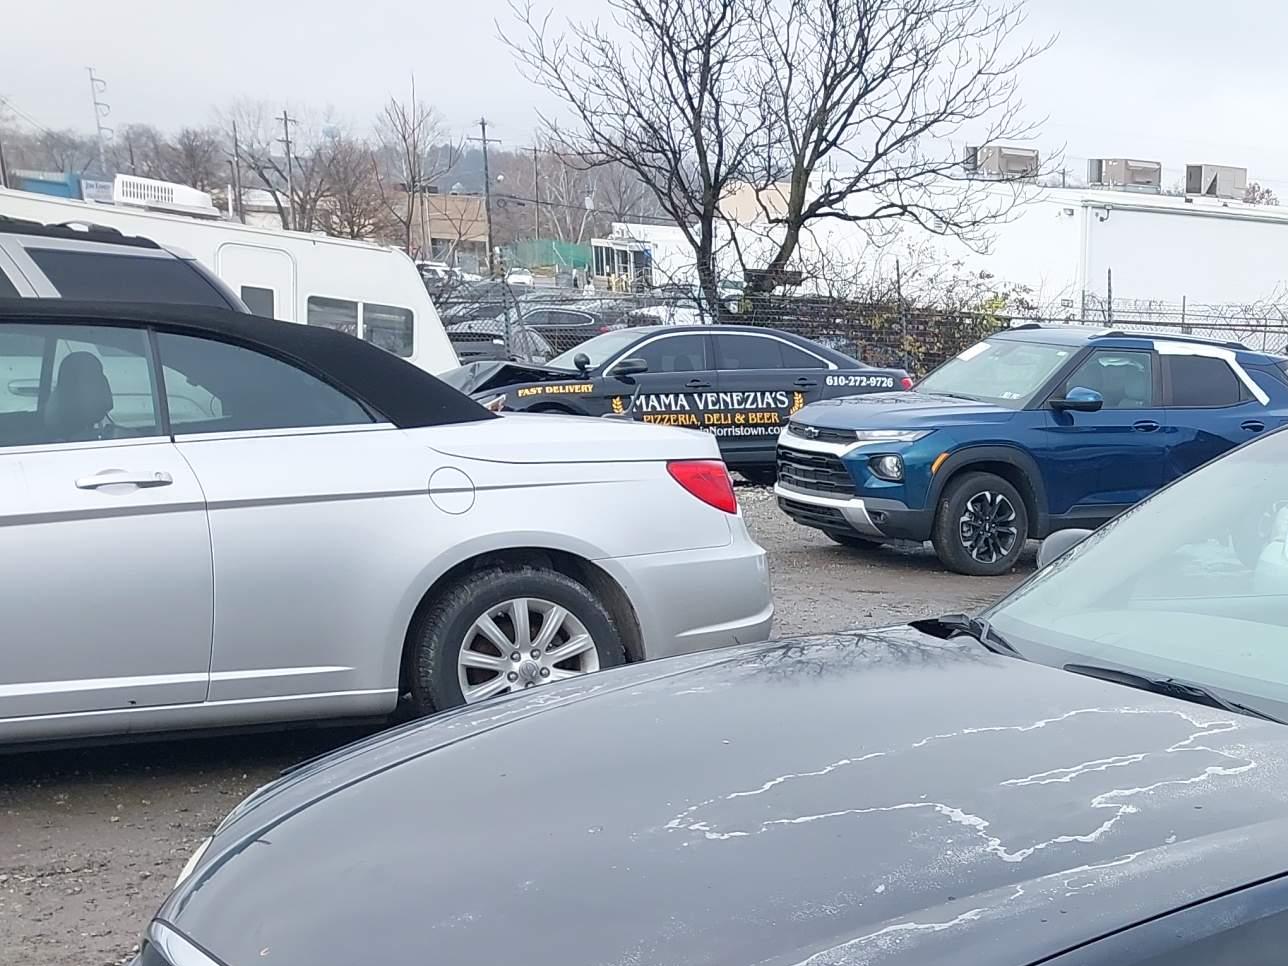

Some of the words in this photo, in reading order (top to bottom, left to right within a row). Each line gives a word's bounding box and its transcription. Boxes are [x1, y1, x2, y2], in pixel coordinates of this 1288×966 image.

[825, 375, 894, 388] 610-272-9726
[517, 386, 543, 397] FAST
[545, 384, 594, 394] DELIVERY
[630, 394, 690, 412] MAMA
[693, 391, 789, 410] VENEZIA'S
[643, 413, 701, 426] PIZZERIA,
[704, 413, 732, 425] DELI
[734, 413, 746, 424] &
[749, 412, 780, 424] BEER
